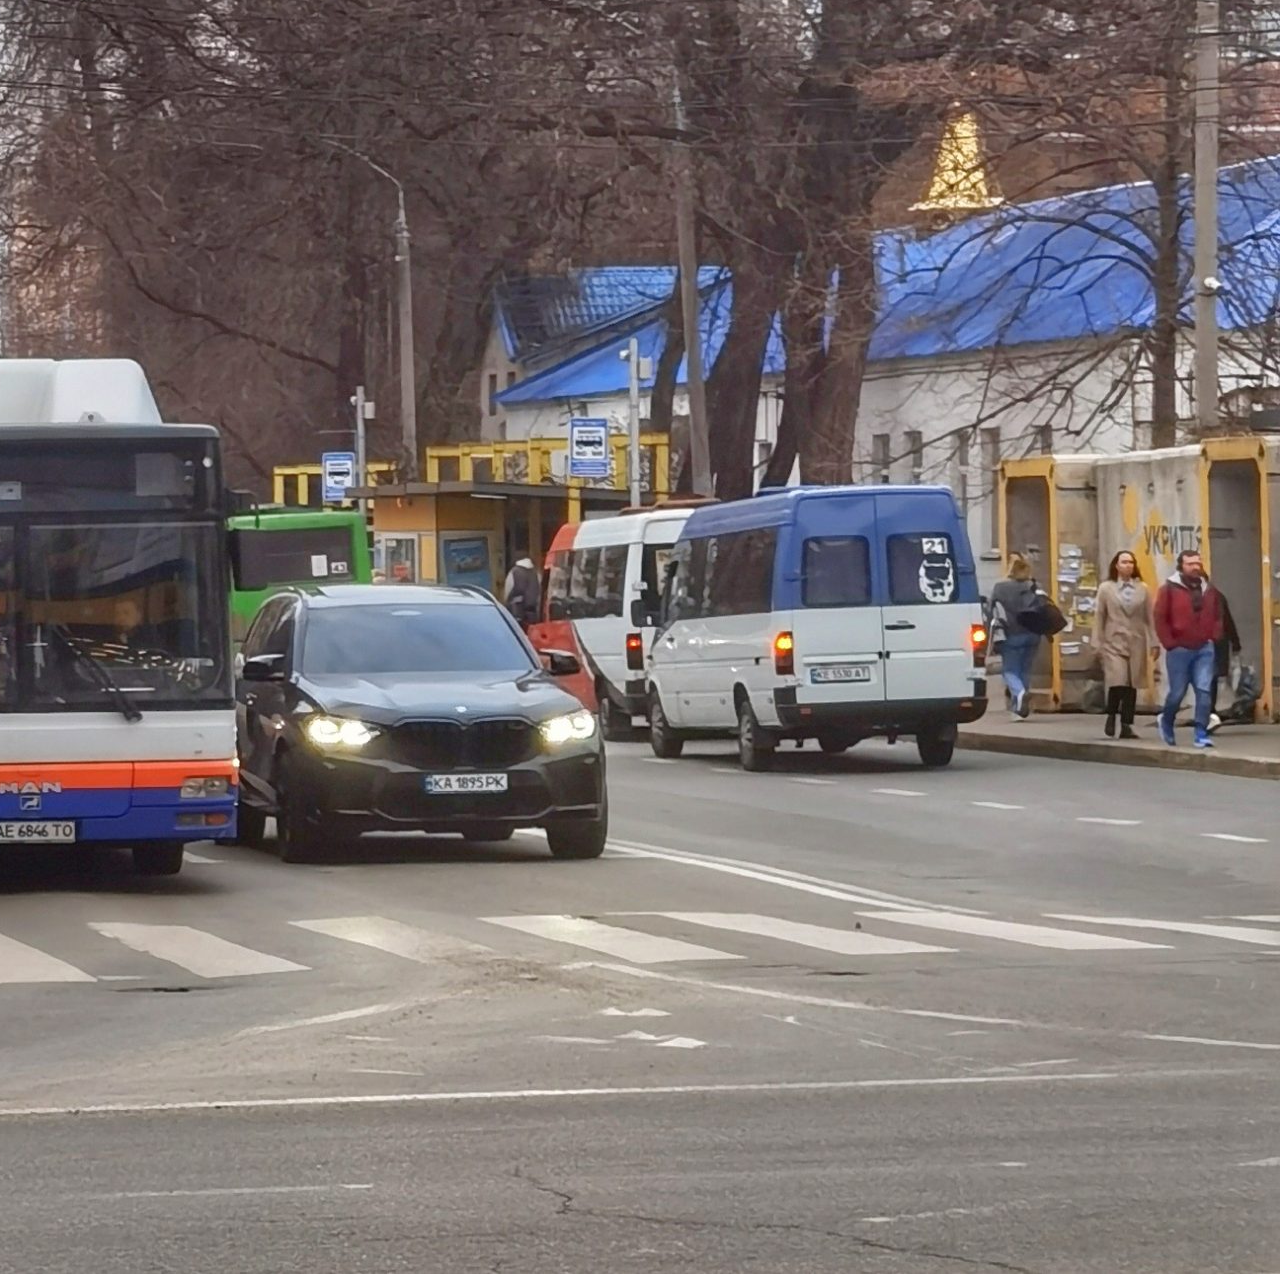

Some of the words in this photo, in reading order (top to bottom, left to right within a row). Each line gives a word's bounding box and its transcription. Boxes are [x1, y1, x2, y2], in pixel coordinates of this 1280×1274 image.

[924, 540, 946, 554] 21
[0, 782, 62, 794] MAN
[18, 824, 48, 837] 6846
[53, 824, 73, 837] TO
